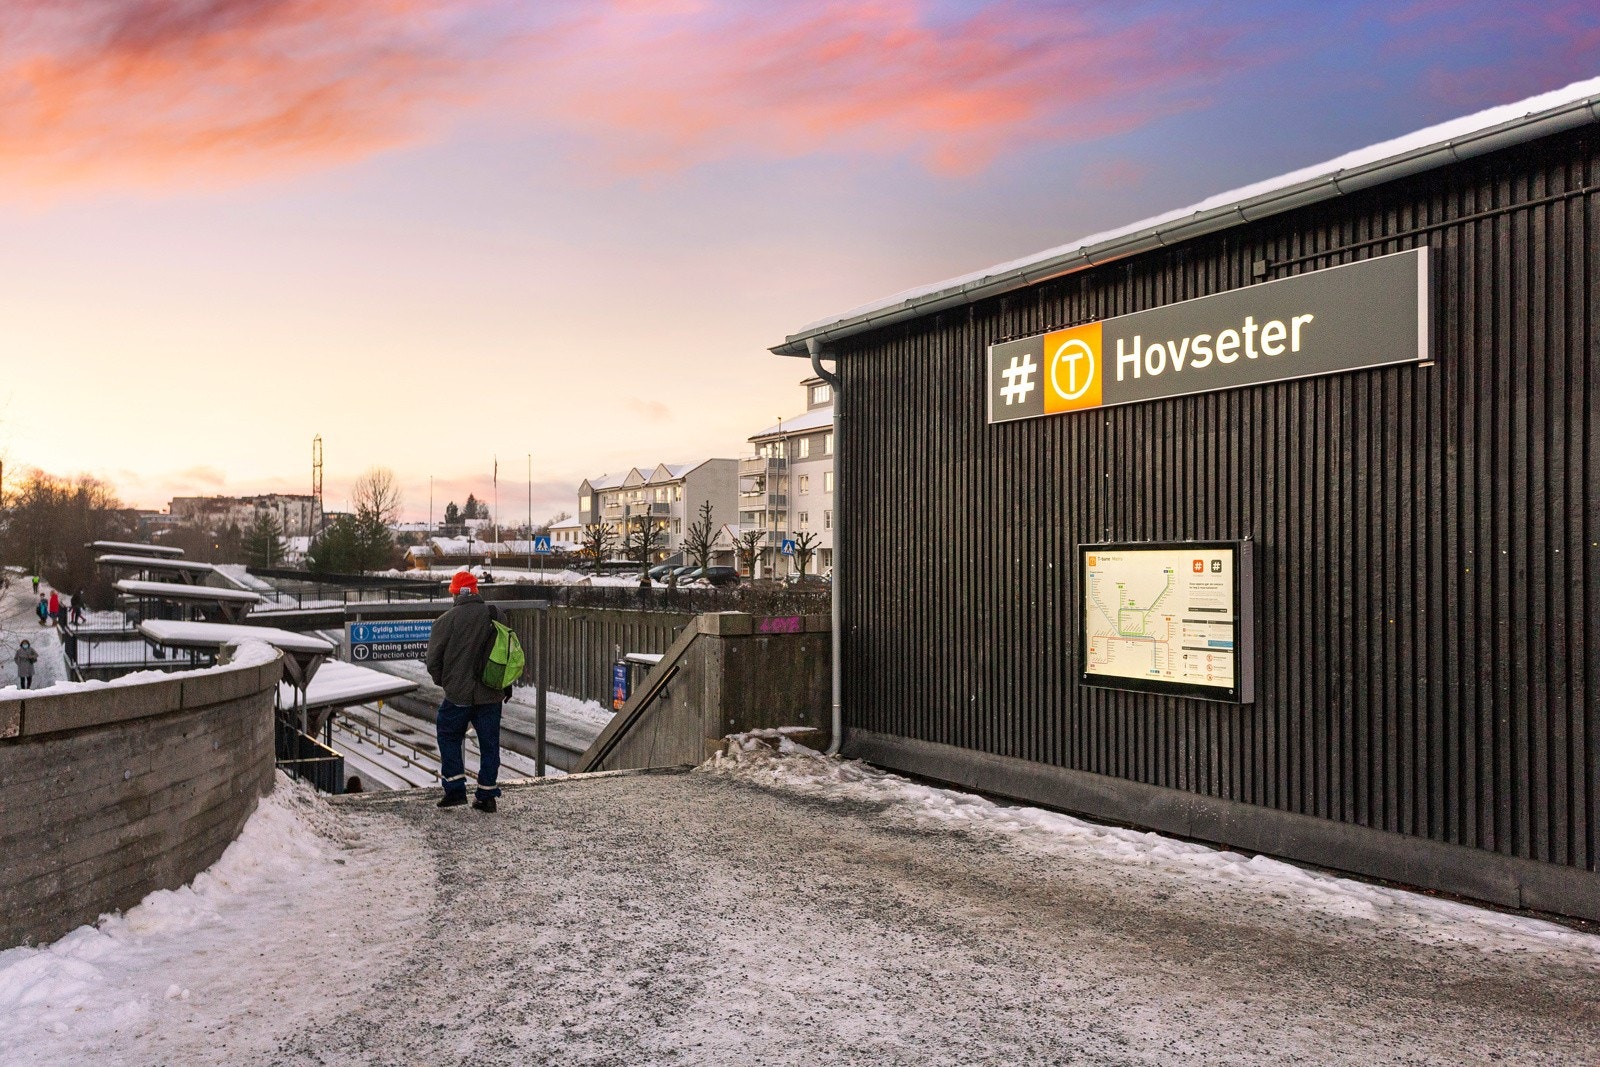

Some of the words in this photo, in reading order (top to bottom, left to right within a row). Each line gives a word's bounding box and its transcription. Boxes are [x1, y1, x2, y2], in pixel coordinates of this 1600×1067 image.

[1116, 312, 1315, 382] Hovseter
[372, 643, 402, 651] Retning
[403, 642, 428, 650] sentru
[372, 651, 405, 660] Direction
